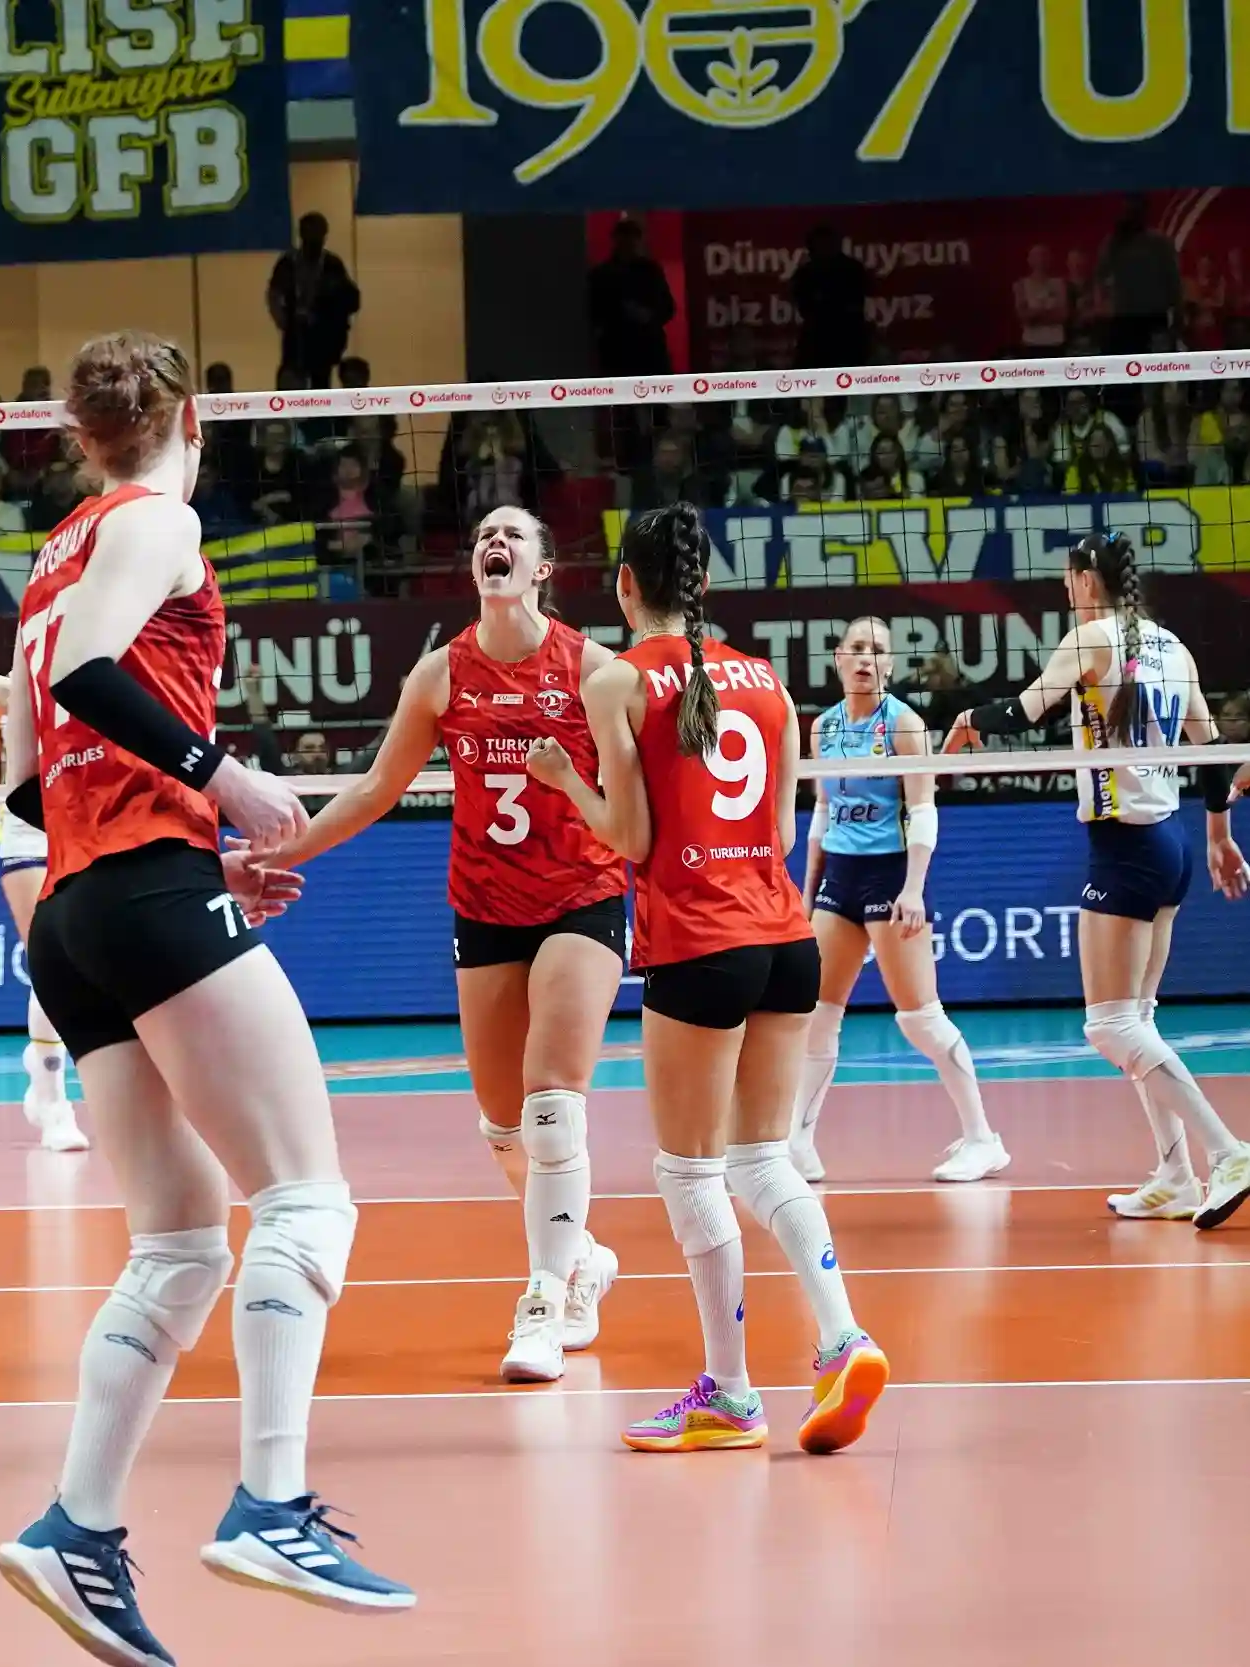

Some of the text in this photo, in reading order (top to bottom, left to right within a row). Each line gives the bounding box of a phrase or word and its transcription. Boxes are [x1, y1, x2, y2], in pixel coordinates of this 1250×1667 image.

[1, 101, 247, 221] GFB
[7, 408, 52, 420] vodafone
[286, 397, 332, 408] vodafone
[427, 391, 474, 403] vodafone
[568, 385, 615, 397] vodafone
[711, 379, 758, 390] vodafone
[854, 373, 901, 385] vodafone
[998, 366, 1046, 379] vodafone
[1144, 361, 1191, 372] vodafone
[485, 737, 534, 751] TURKI
[703, 709, 768, 821] 9
[484, 774, 531, 845] 3
[709, 845, 774, 861] TURKISH AIR
